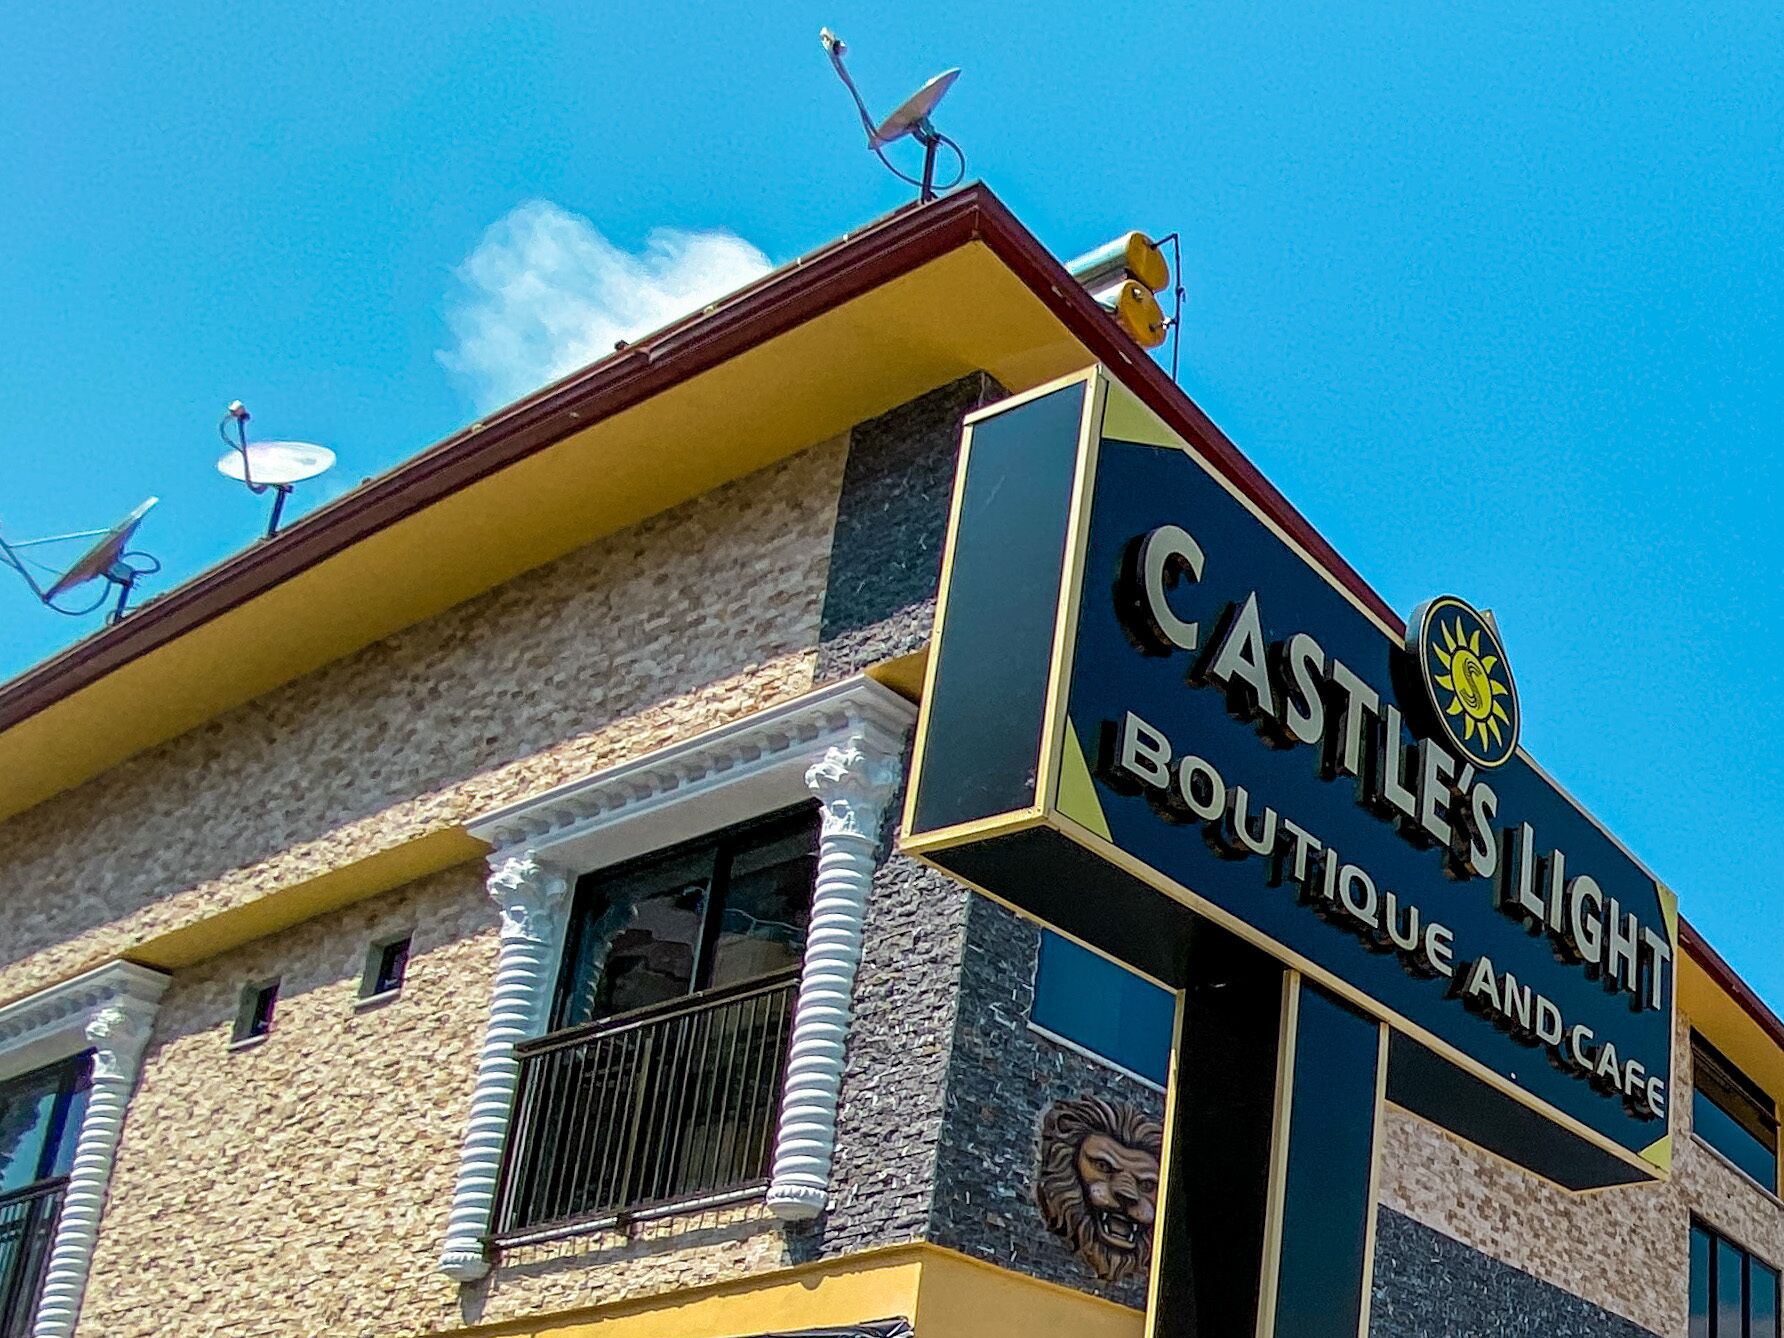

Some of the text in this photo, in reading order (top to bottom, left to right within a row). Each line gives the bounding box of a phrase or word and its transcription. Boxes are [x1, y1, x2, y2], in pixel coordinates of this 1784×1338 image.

[1119, 710, 1665, 1120] BOUTIQUE AND CAFE
[1143, 523, 1671, 1011] CASTLE'S LIGHT
